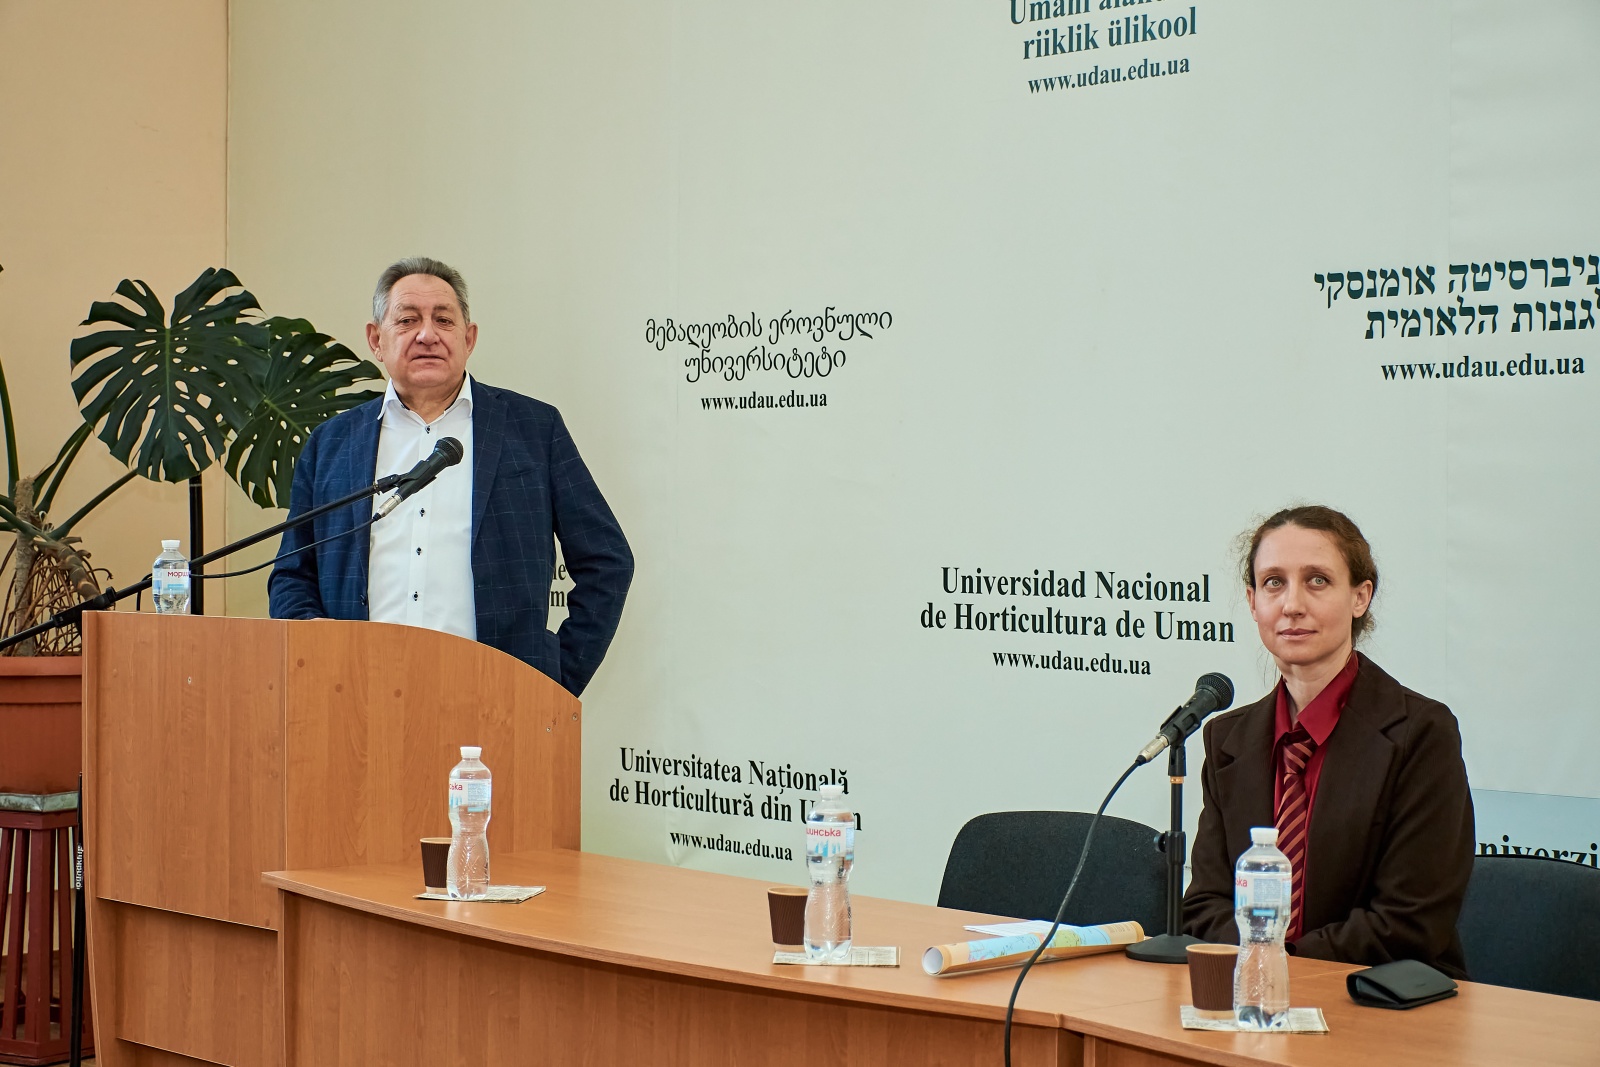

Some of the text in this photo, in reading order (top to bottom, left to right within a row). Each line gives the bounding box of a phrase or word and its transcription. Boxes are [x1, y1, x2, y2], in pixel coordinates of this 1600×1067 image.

[1023, 6, 1197, 60] riiklik ülikool
[1028, 57, 1190, 94] www.udau.edu.ua
[1314, 264, 1436, 309] אומנסקי
[645, 306, 893, 351] მებაღეობის ეროვნული
[1365, 295, 1498, 339] הלאומית
[684, 345, 847, 383] უნივერსიტეტი
[1381, 353, 1585, 381] www.udau.edu.ua
[701, 390, 828, 410] www.udau.edu.ua
[941, 566, 1211, 603] Universidad Nacional
[920, 602, 1235, 643] de Horticultura de Uman
[993, 650, 1151, 675] www.udau.edu.ua
[619, 747, 742, 783] Universitatea
[609, 778, 862, 831] de Horticultură din Un
[669, 832, 793, 862] www.udau.edu.ua
